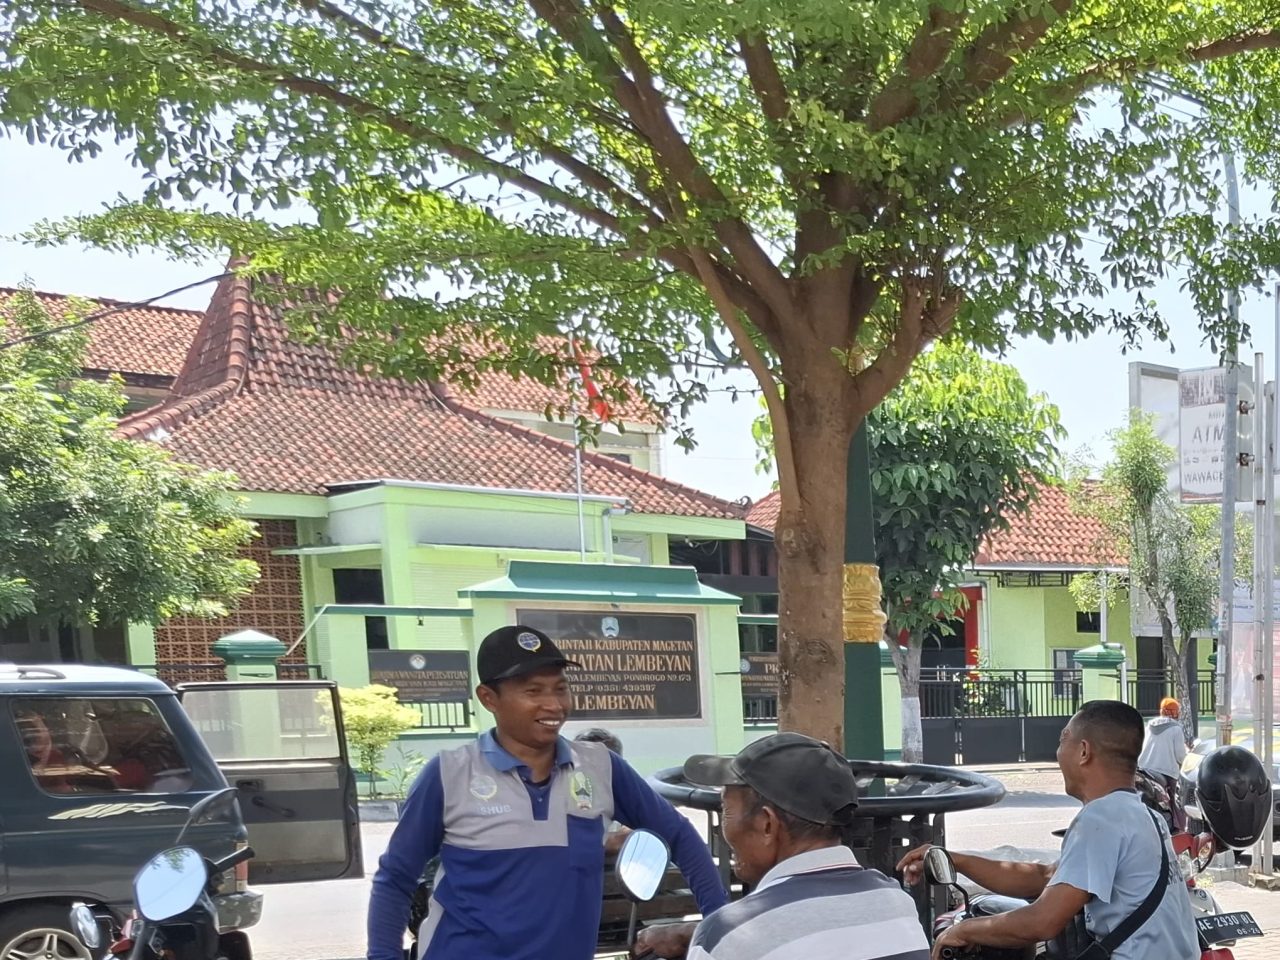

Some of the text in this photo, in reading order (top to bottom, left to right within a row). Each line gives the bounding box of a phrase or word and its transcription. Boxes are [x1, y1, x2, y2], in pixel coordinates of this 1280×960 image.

[594, 639, 651, 651] KABUPATEN
[652, 640, 693, 651] MAGETAN
[565, 654, 691, 671] MATAN LEMBEYAN
[573, 695, 655, 711] LEMBEYAN
[1198, 919, 1213, 931] AE
[1214, 914, 1239, 928] 2930
